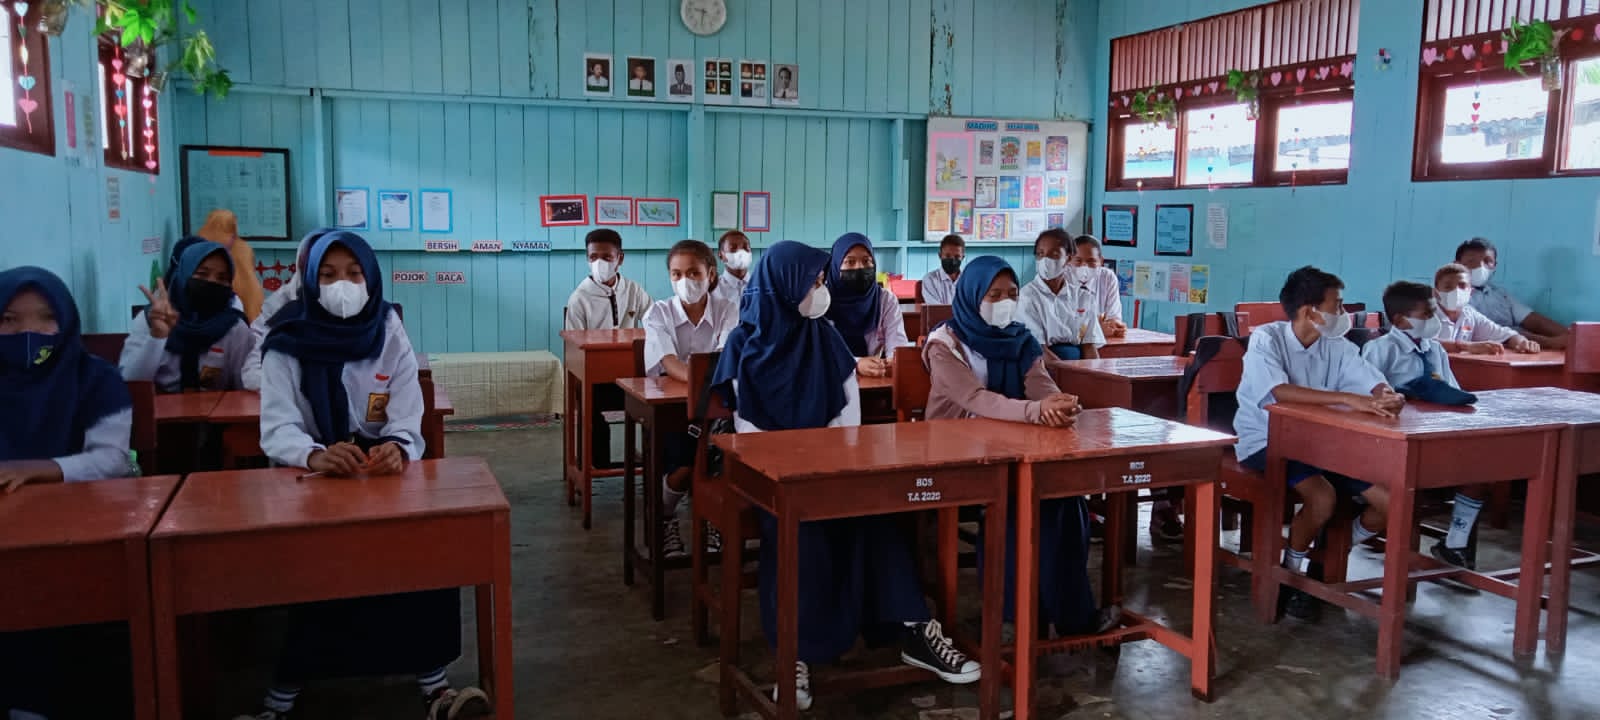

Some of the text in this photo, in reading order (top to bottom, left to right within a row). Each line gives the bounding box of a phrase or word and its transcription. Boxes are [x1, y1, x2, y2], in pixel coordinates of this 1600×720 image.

[426, 241, 551, 250] BERSIH AMAN NYAMAN
[394, 273, 463, 282] POJOK BACA
[916, 478, 933, 487] BOS
[921, 491, 941, 502] 2020
